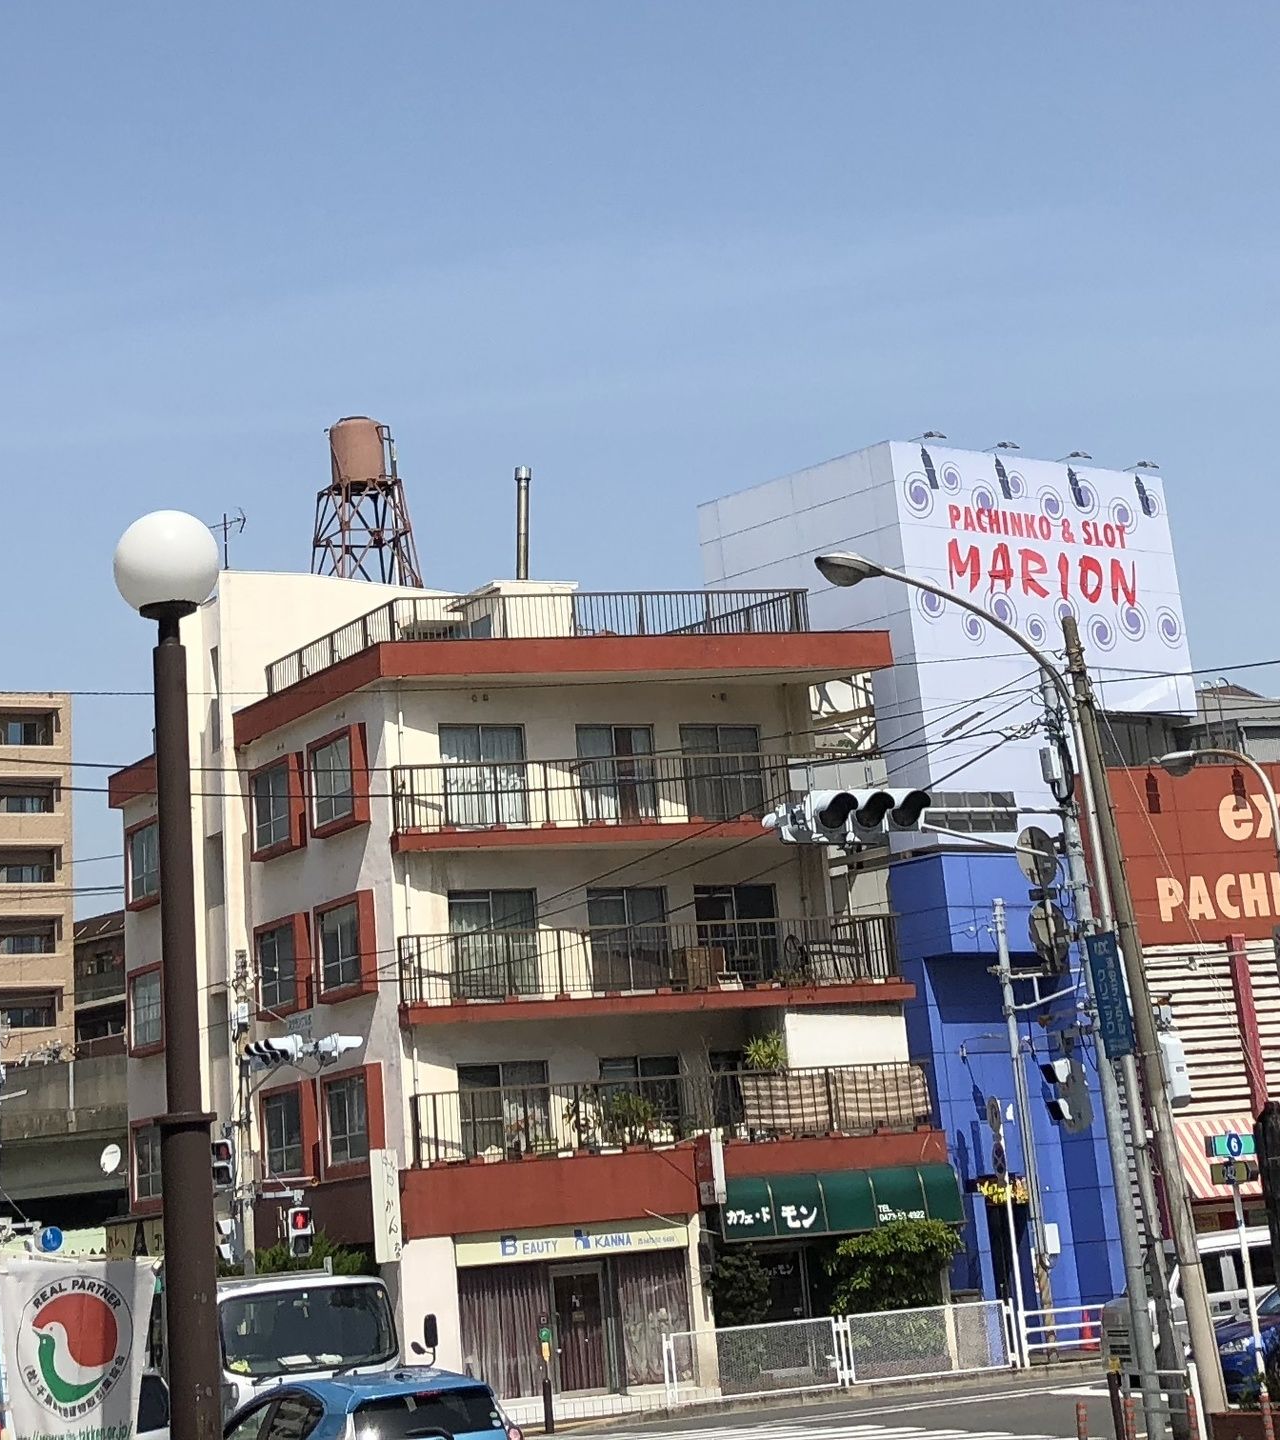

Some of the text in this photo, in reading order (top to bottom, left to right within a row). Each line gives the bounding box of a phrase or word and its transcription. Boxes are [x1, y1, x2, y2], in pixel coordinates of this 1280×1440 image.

[948, 503, 1127, 549] PACHINKO & SLOT
[947, 538, 1137, 608] MARION
[1230, 1137, 1239, 1153] 6
[594, 1233, 632, 1249] KANNA
[32, 1279, 121, 1309] REAL PARTNER
